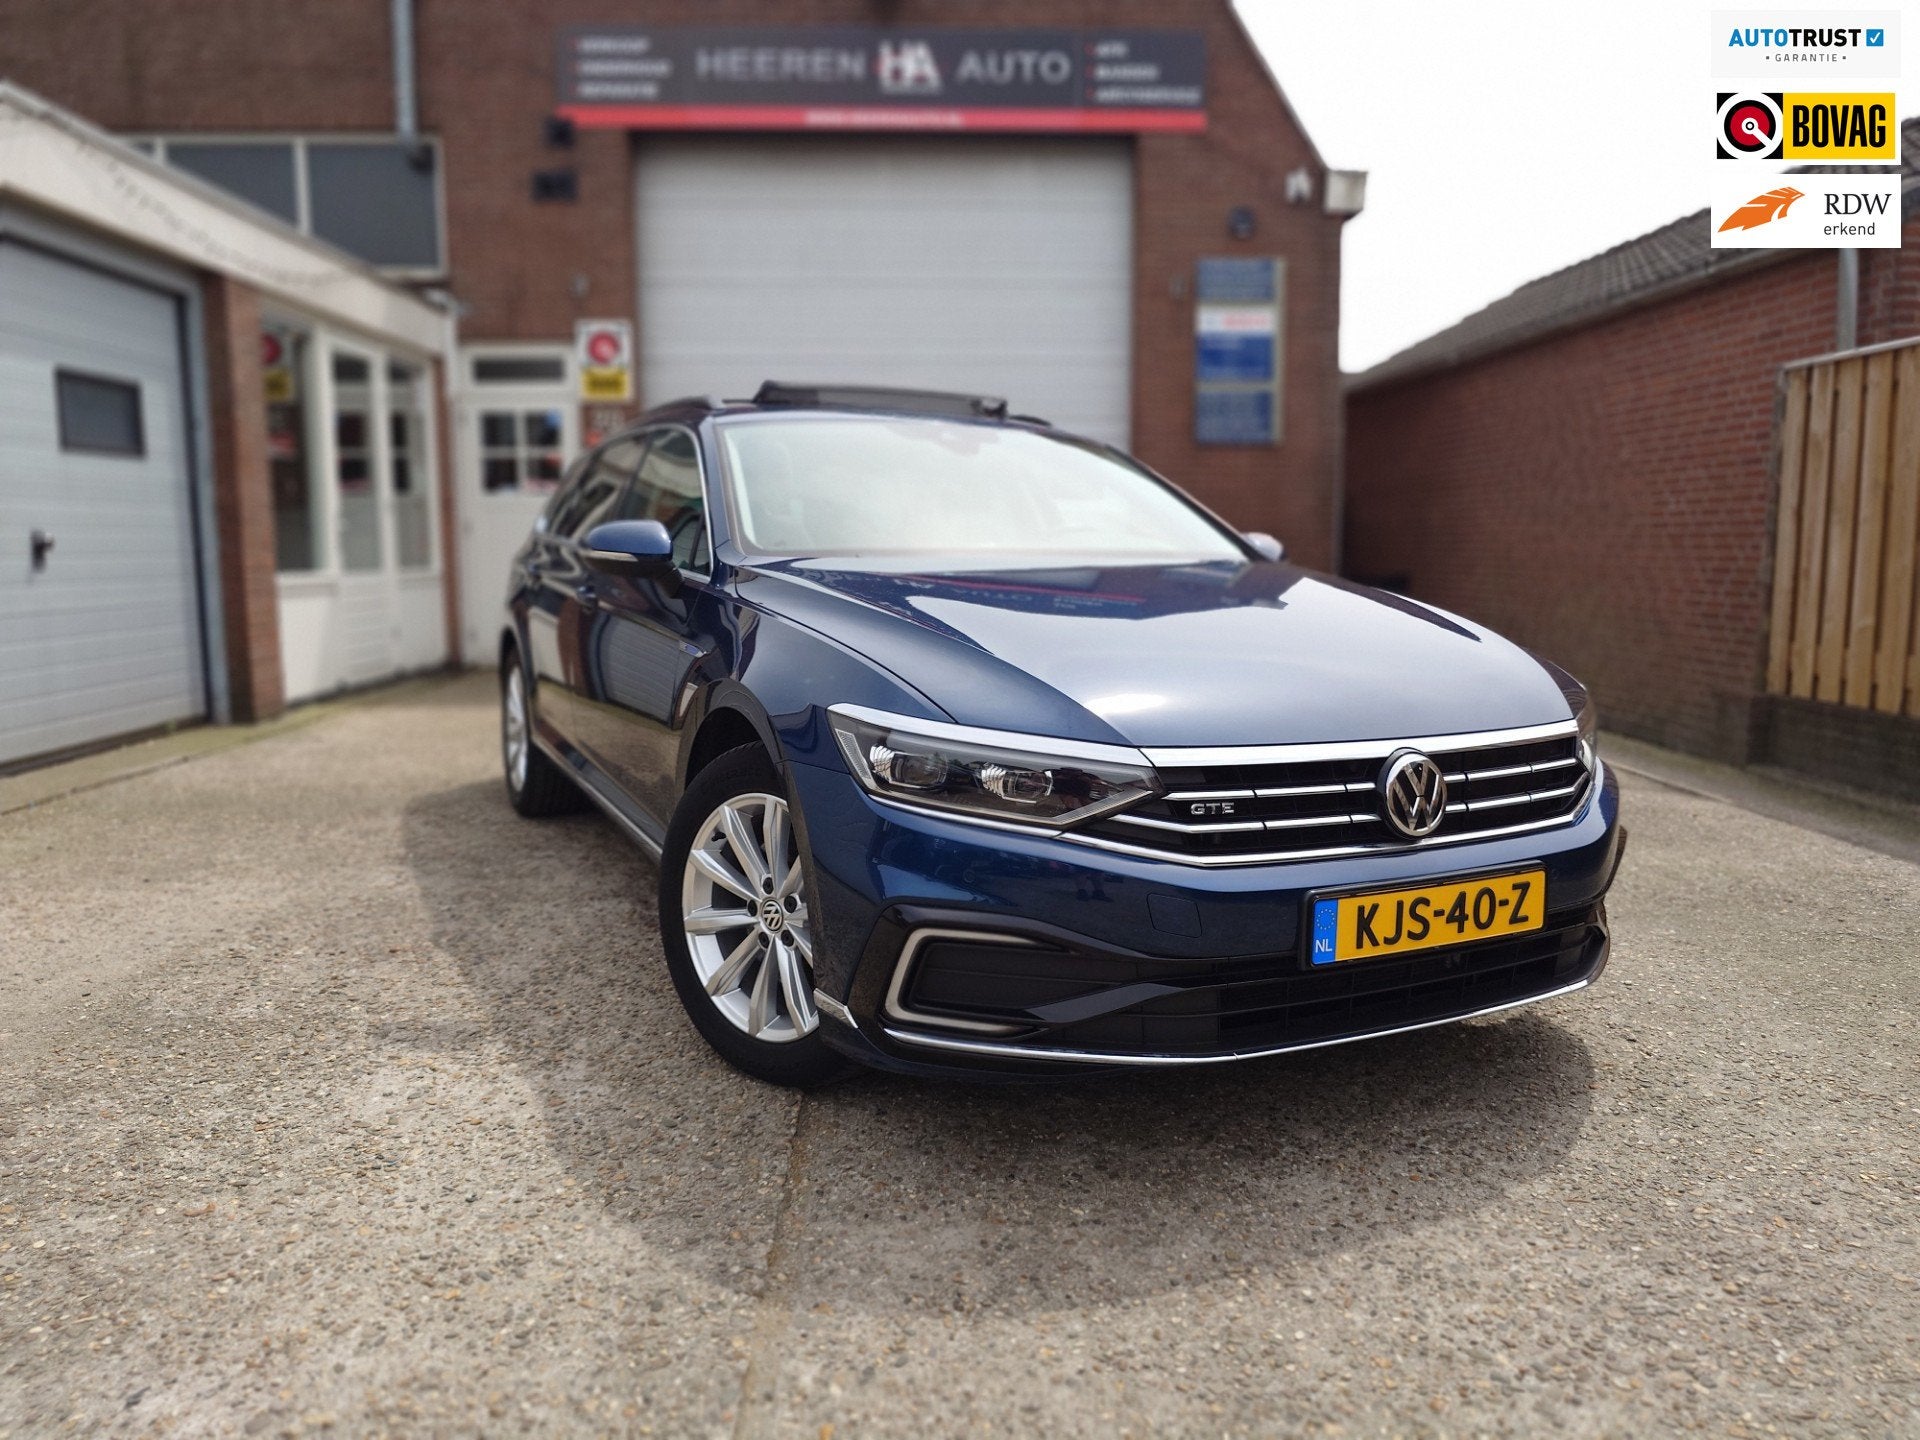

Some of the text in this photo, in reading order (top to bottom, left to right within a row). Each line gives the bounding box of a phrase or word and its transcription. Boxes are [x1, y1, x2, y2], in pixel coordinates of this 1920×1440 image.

[695, 47, 866, 81] HEEREN
[957, 50, 1071, 84] AUTO
[1190, 802, 1235, 816] GTE
[1355, 880, 1531, 950] KJS-40-Z
[1314, 939, 1333, 954] NL
